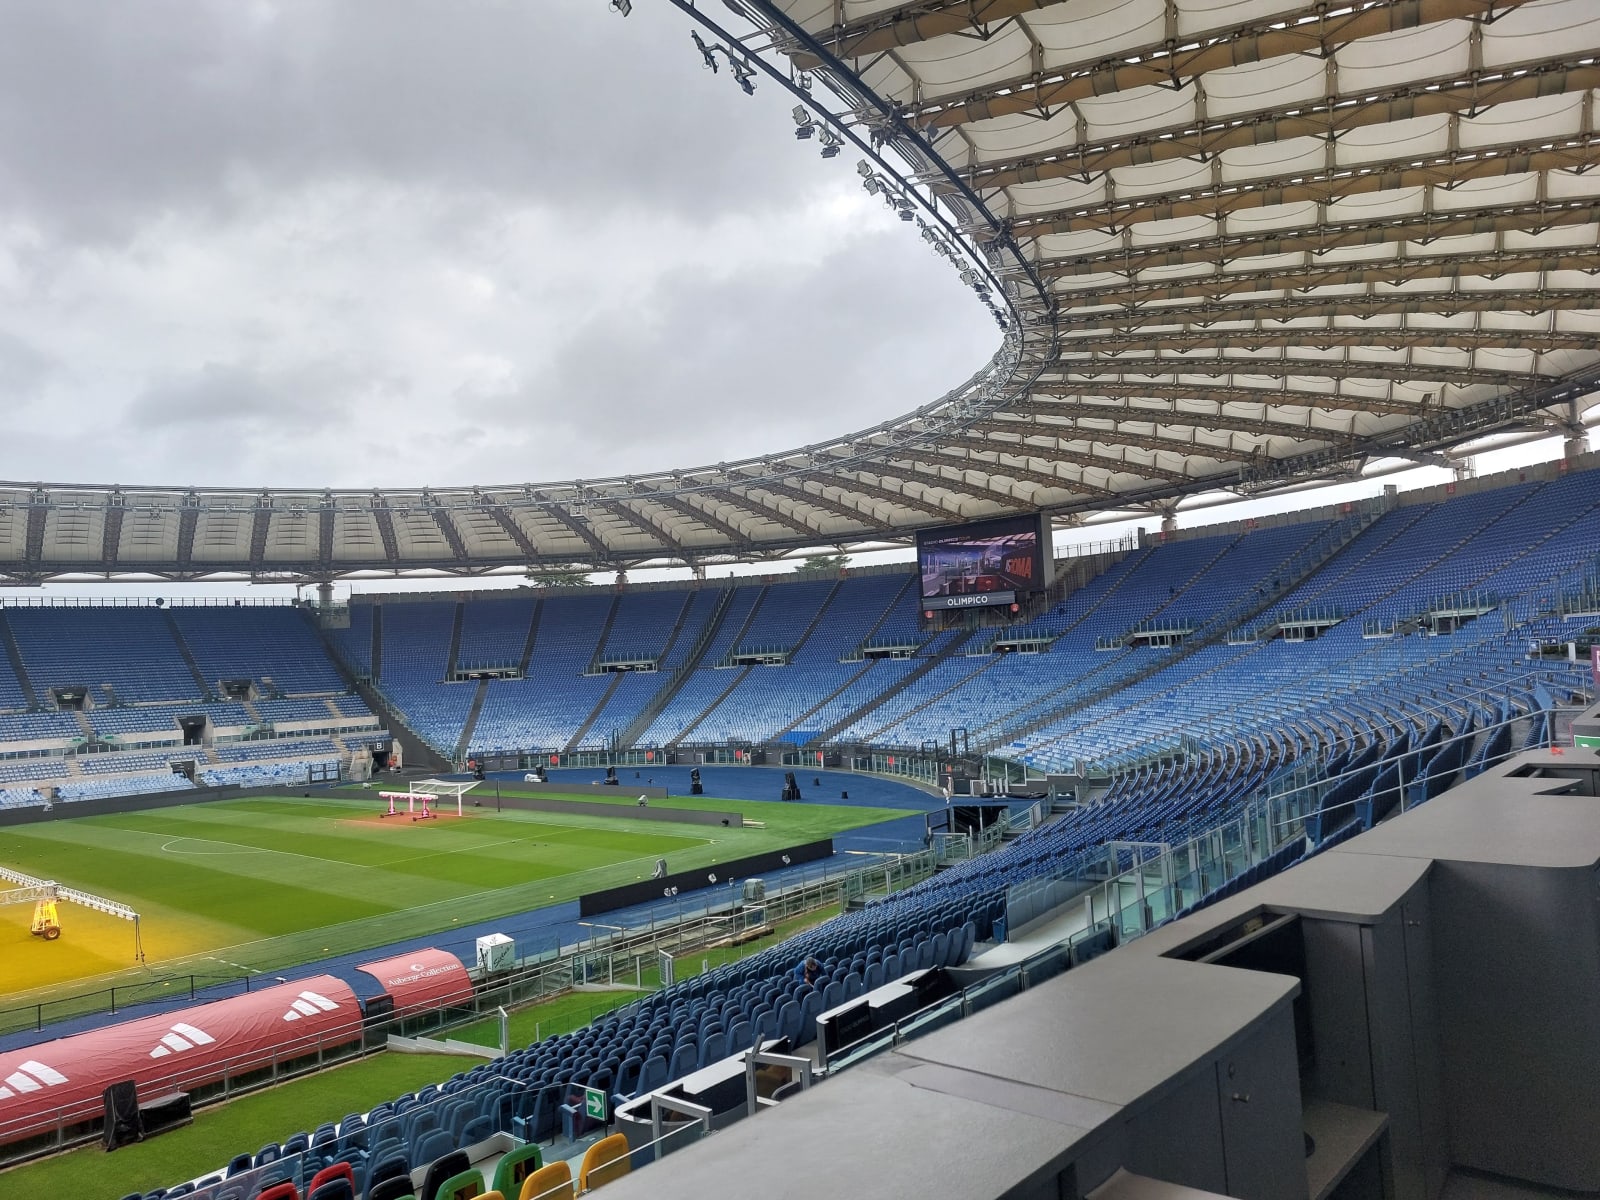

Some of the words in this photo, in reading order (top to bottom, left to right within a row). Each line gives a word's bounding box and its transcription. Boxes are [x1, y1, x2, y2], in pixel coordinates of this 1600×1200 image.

[948, 596, 988, 606] OLIMPICO
[388, 974, 420, 986] Auberge
[420, 964, 458, 977] Collection
